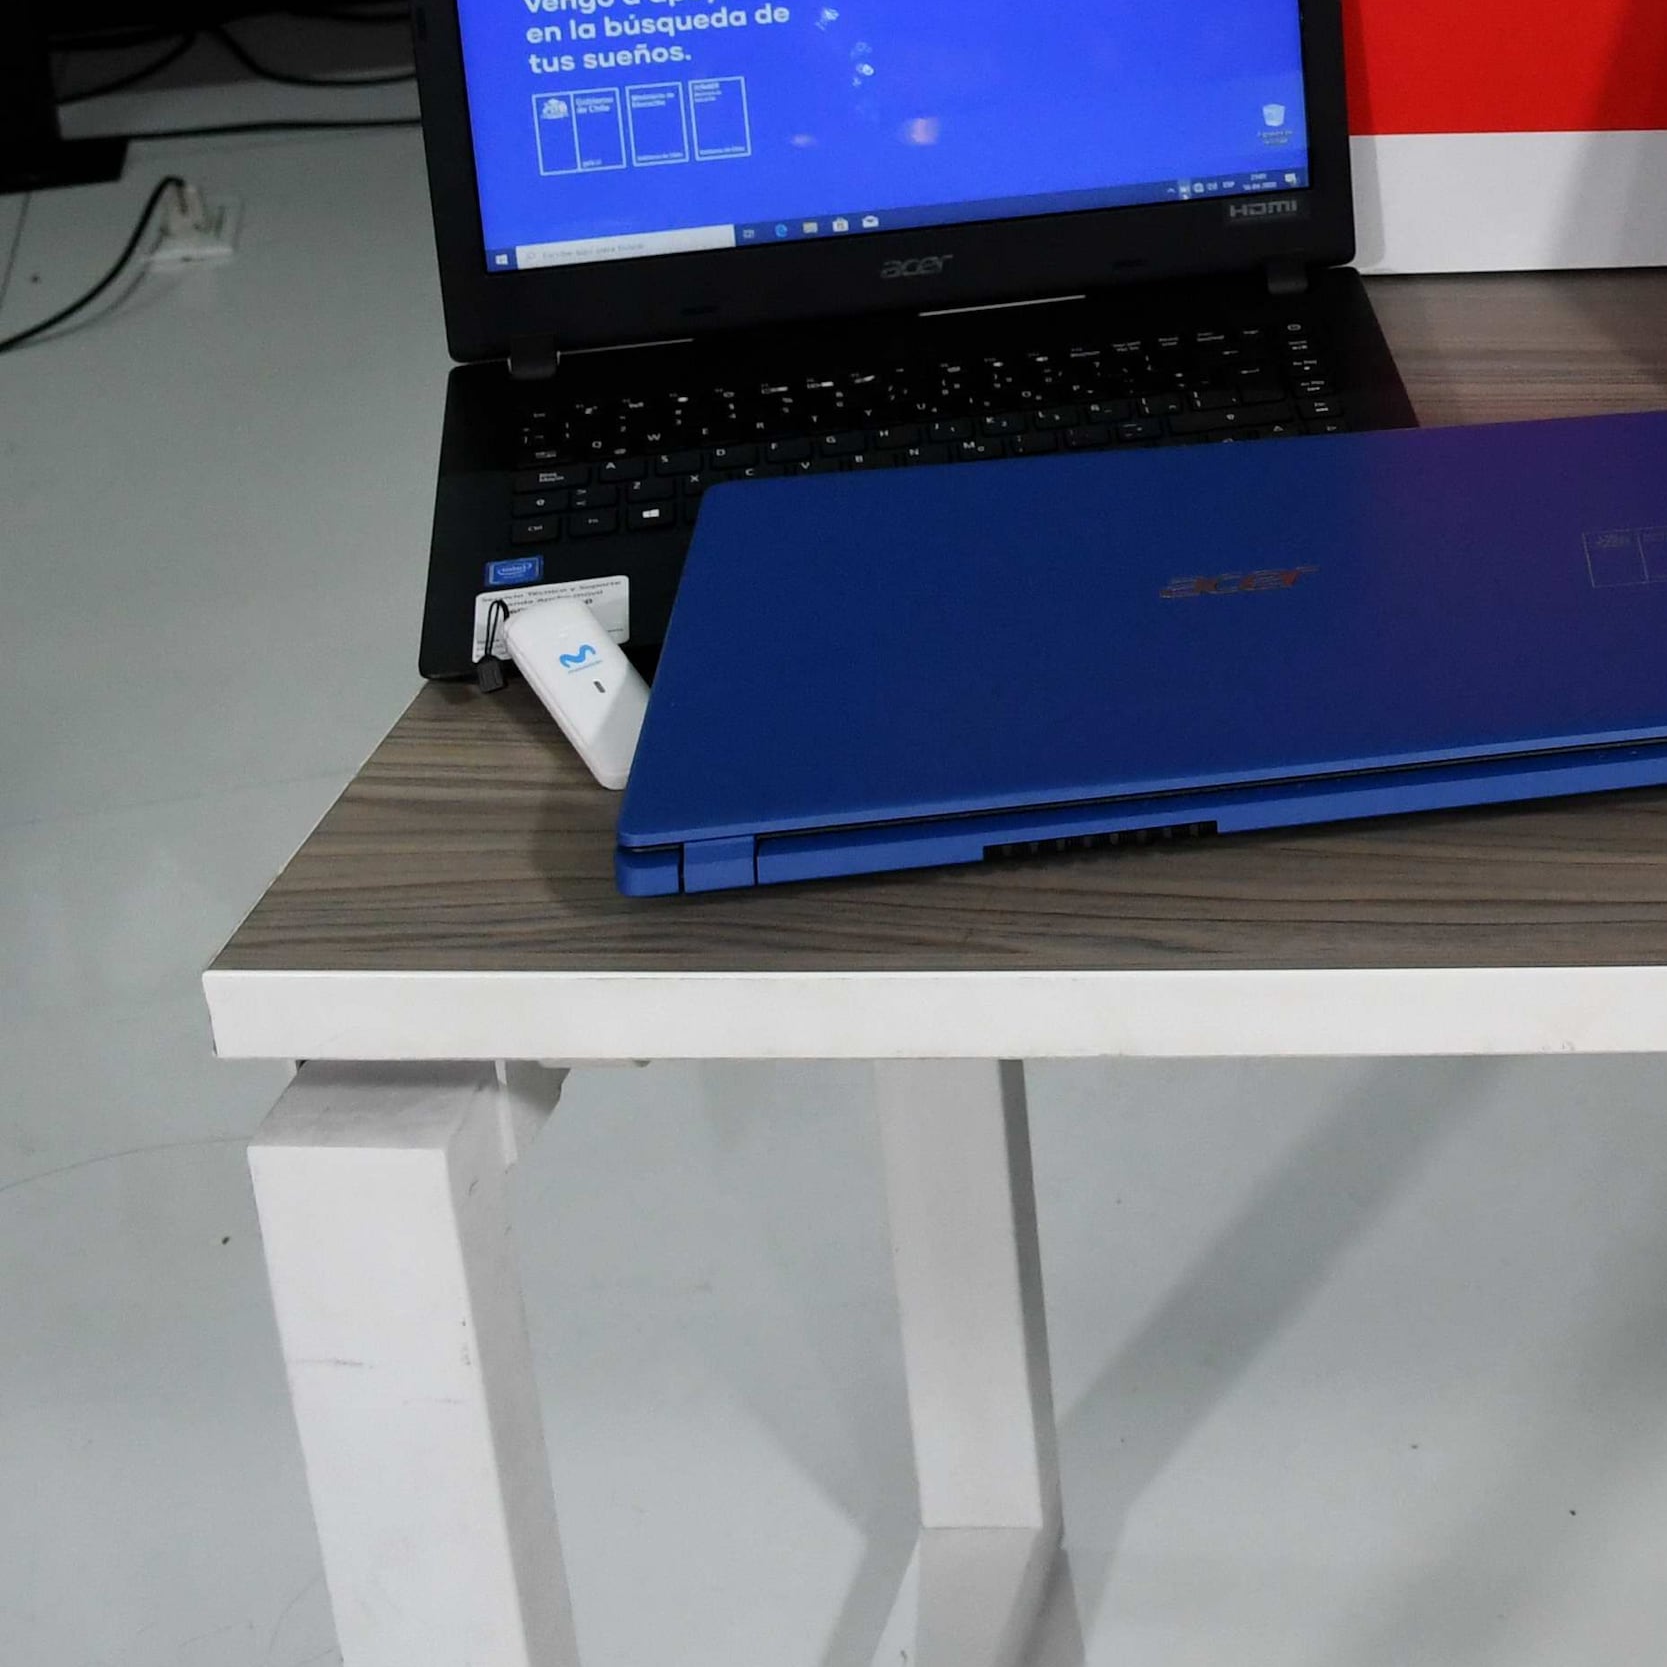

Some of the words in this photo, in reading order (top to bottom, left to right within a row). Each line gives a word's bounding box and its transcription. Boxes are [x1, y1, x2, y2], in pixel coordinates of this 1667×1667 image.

[526, 27, 561, 44] en
[570, 19, 596, 40] la
[604, 7, 747, 37] búsqueda
[755, 4, 790, 24] de
[529, 53, 575, 74] tus
[583, 44, 692, 69] sueños.
[1229, 199, 1298, 219] HDMI
[881, 254, 953, 278] acer
[1159, 564, 1320, 599] acer
